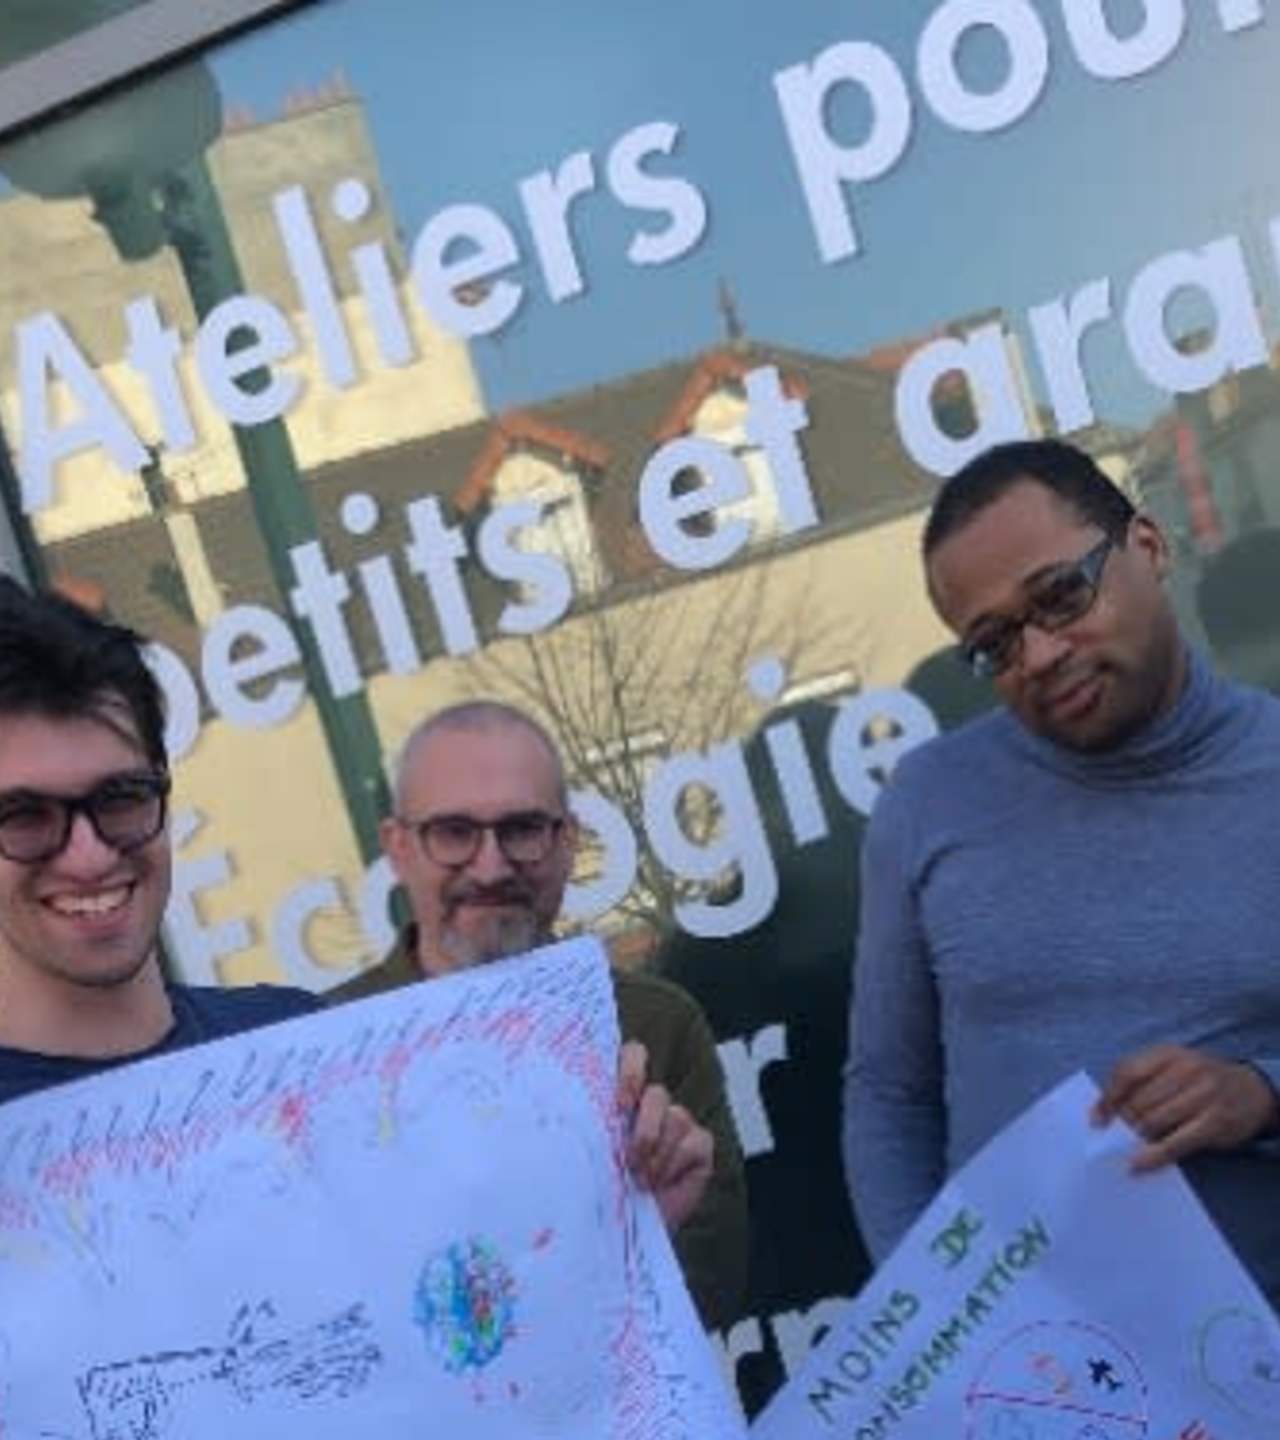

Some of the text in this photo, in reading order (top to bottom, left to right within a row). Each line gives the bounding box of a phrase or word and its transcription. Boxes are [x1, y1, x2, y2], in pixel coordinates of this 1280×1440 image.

[10, 0, 1266, 516] Ateliers pou
[638, 364, 820, 571] et
[807, 1289, 921, 1426] MOINS
